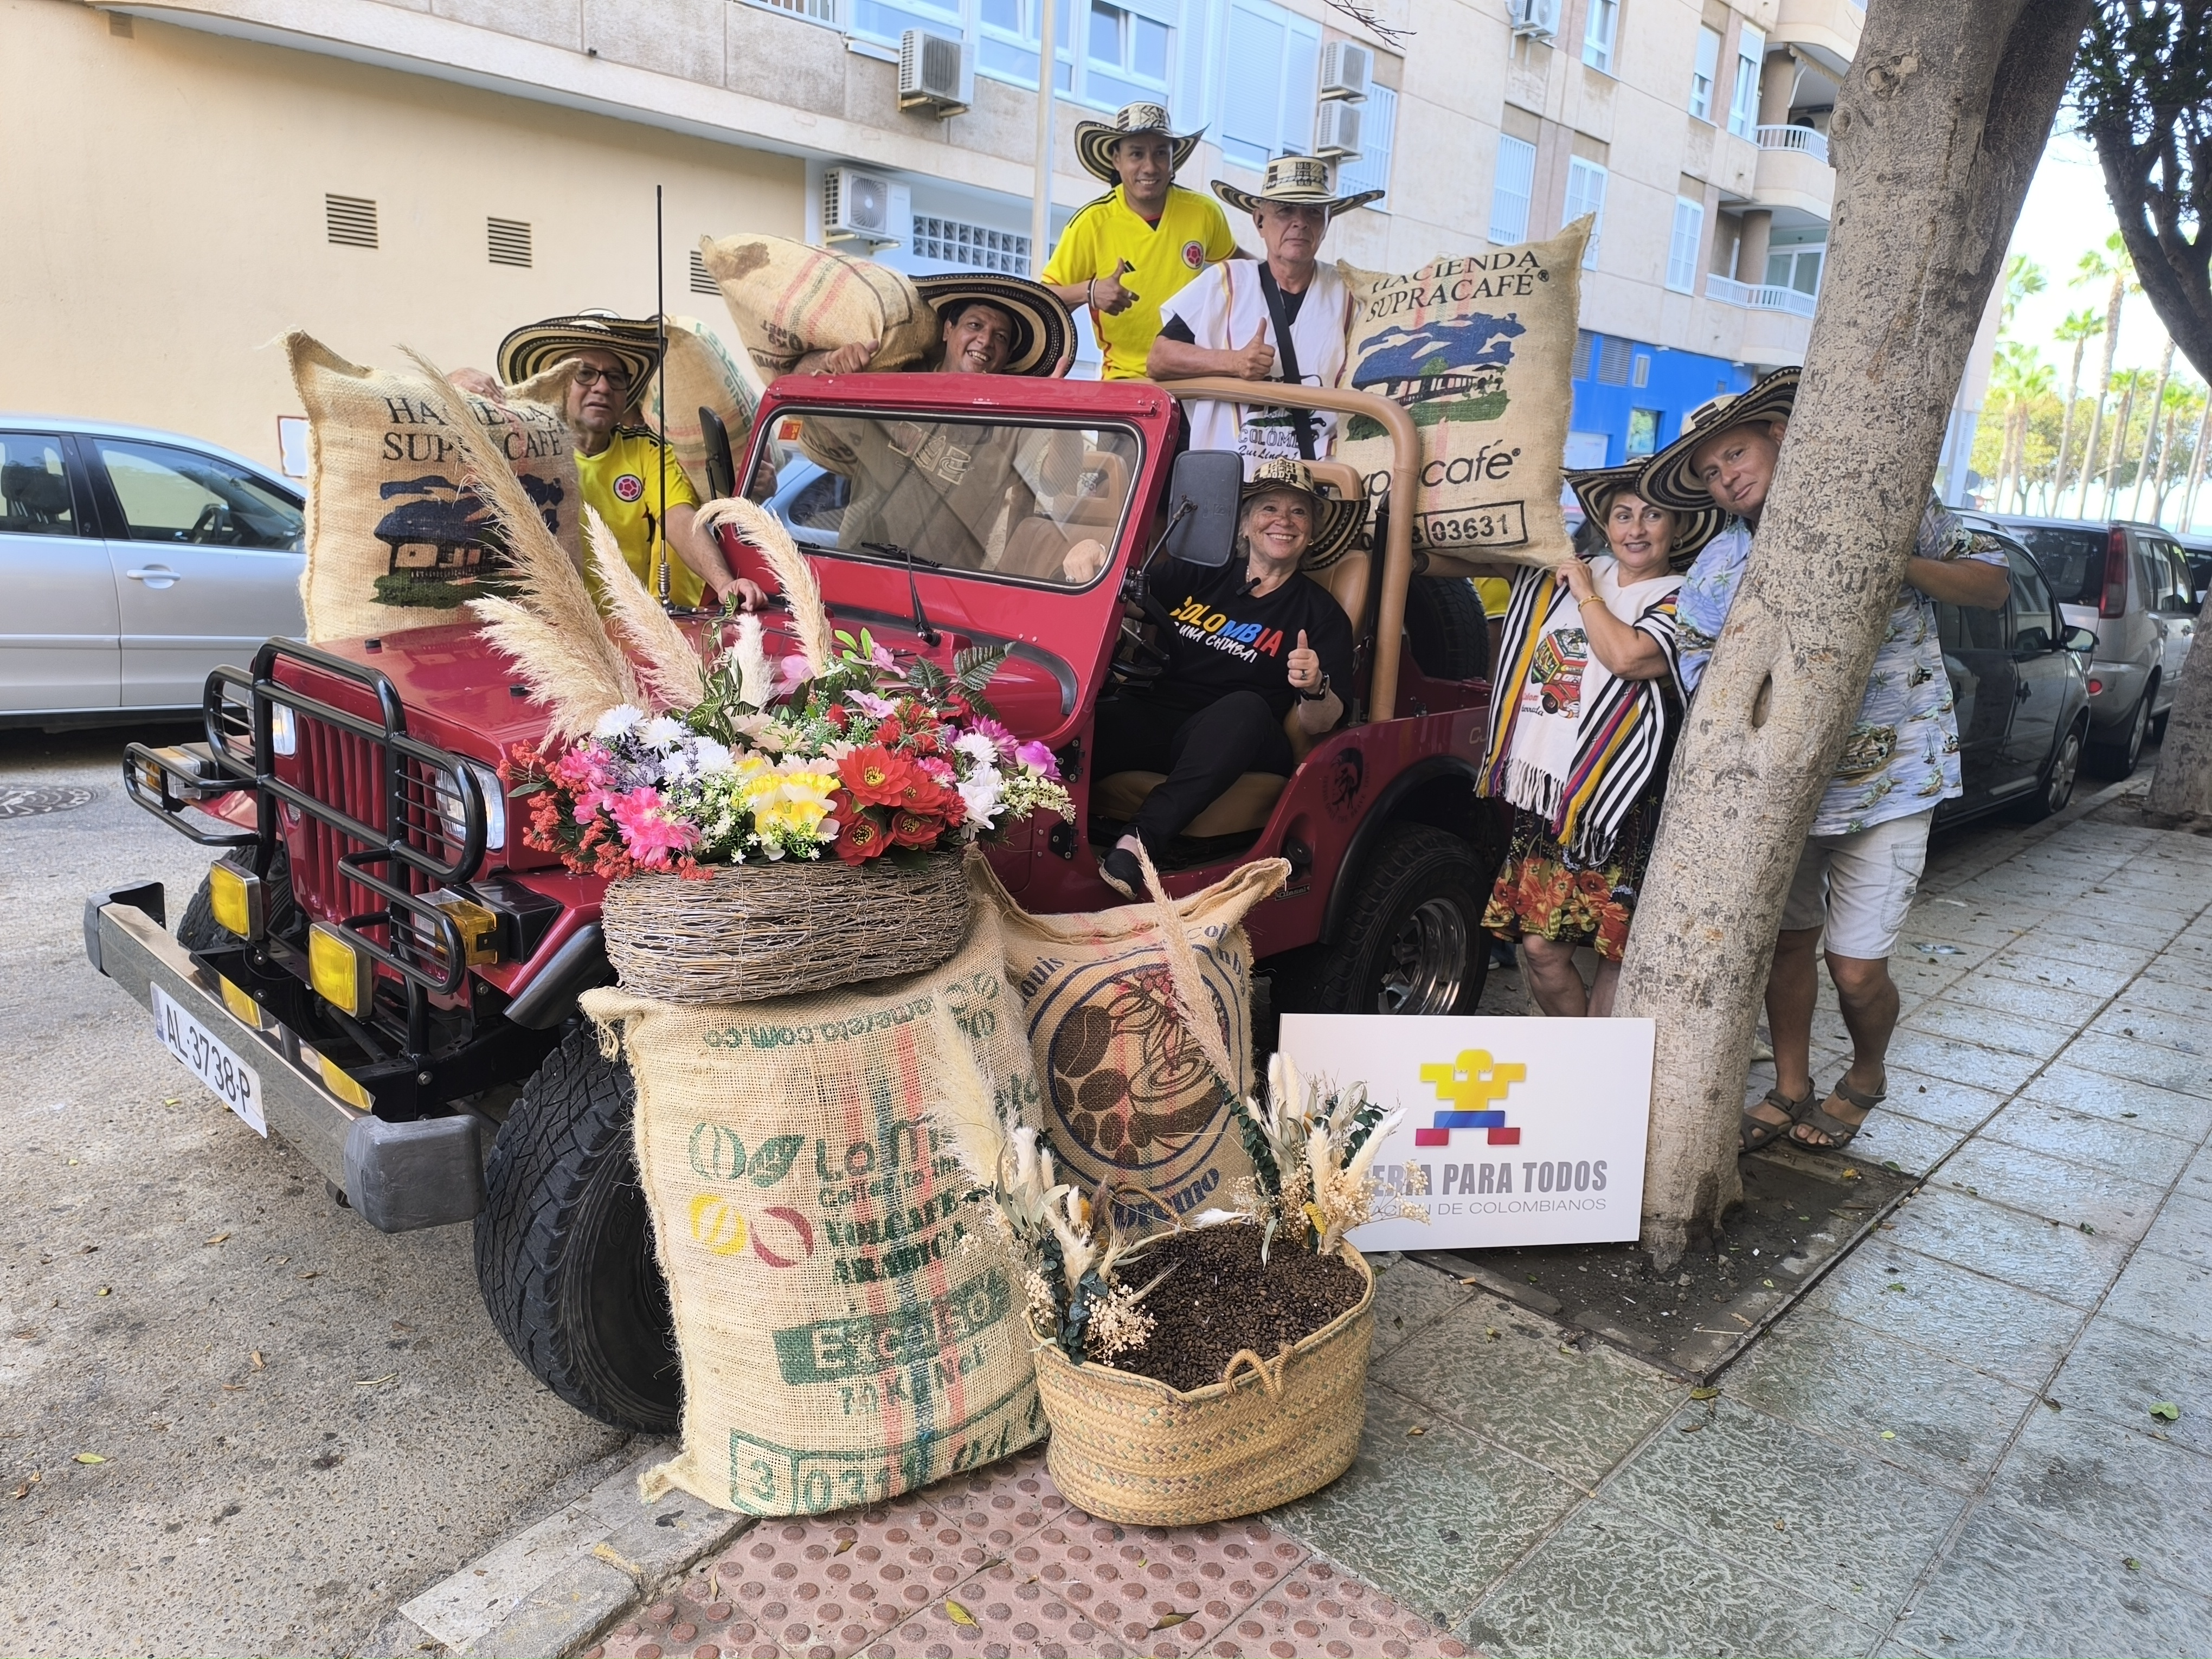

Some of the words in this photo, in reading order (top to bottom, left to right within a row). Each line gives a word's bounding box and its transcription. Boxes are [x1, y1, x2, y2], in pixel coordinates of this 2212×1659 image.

[1371, 250, 1541, 294] HACIENDA
[1430, 513, 1510, 542] 03631
[1442, 1163, 1513, 1195] PARA
[1522, 1160, 1608, 1192] TODOS
[1438, 1203, 1463, 1215] DE
[1469, 1199, 1607, 1215] COLOMBIANOS
